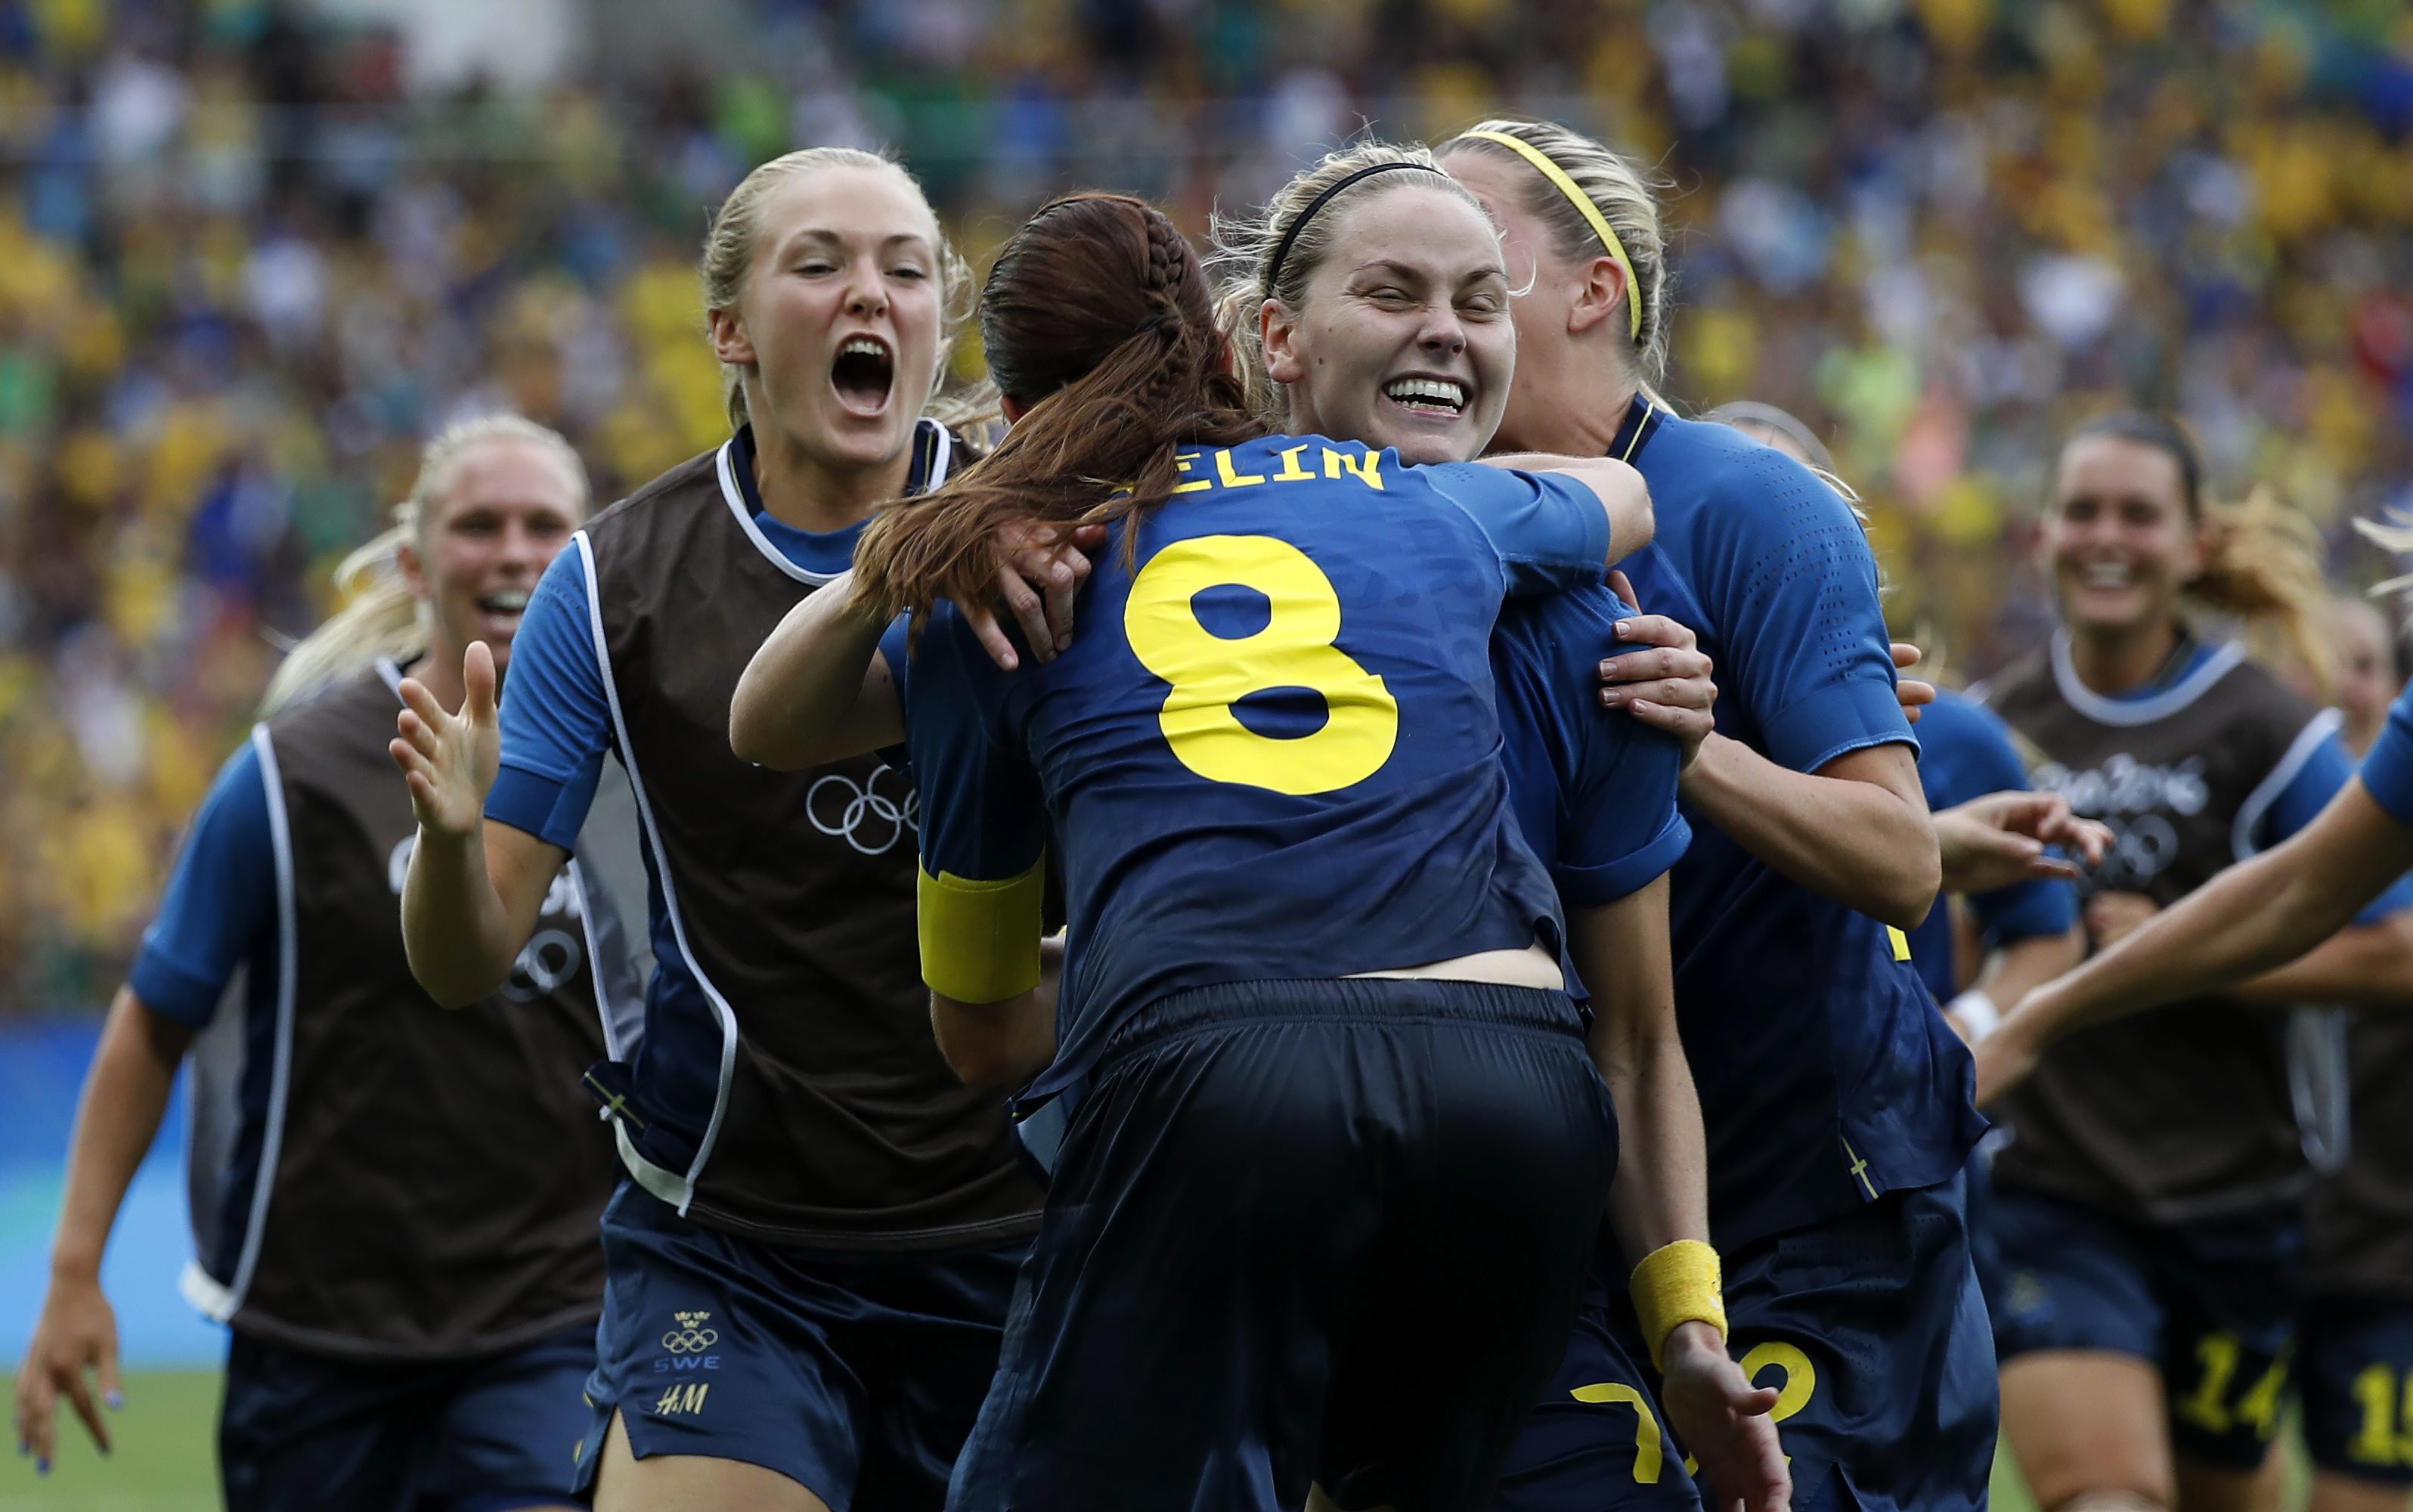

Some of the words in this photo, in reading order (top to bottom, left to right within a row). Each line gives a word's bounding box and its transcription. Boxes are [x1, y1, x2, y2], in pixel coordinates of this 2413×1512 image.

[1111, 444, 1385, 495] ELIN
[1124, 534, 1399, 796] 8
[654, 1356, 721, 1373] SWE
[654, 1383, 710, 1416] H&M
[1569, 1382, 1662, 1484] 7
